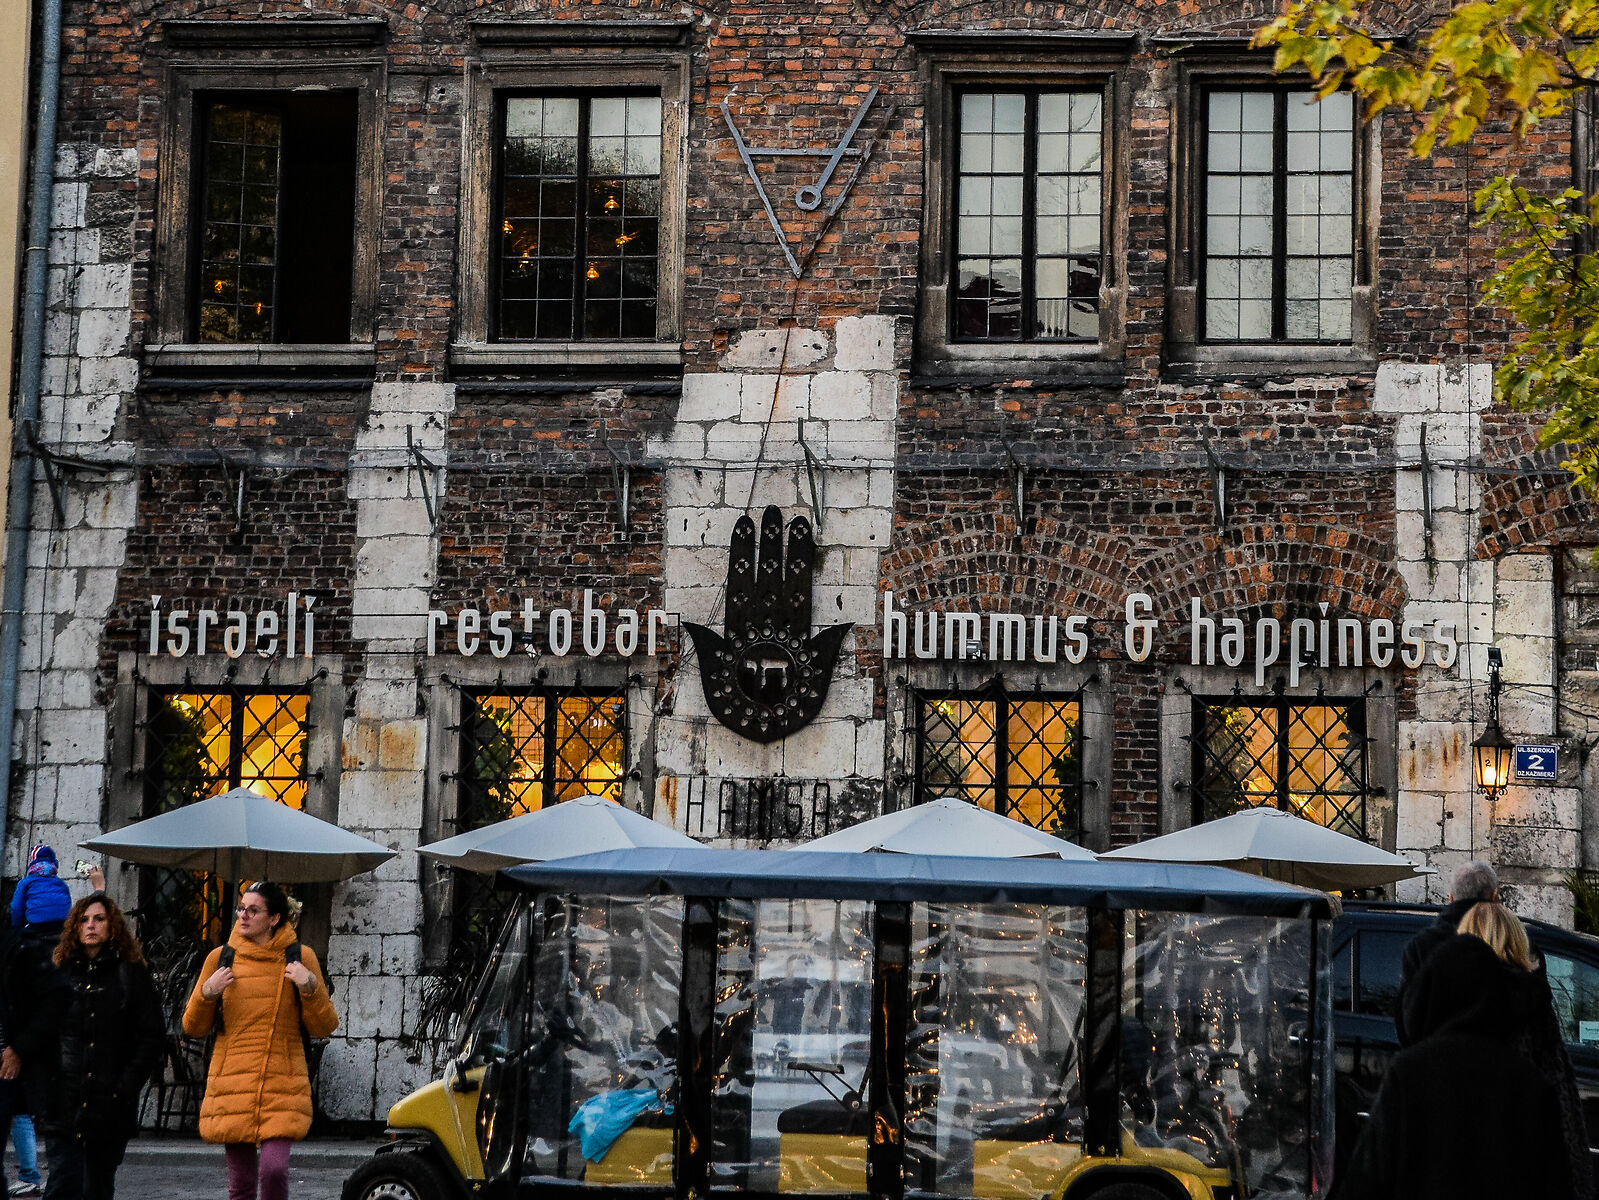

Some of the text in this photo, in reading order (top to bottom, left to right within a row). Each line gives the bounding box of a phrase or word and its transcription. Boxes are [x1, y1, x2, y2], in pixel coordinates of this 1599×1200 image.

[150, 588, 669, 659] israeli restobar
[883, 590, 1457, 688] hummus & happiness
[1527, 754, 1545, 770] 2
[685, 776, 831, 837] HAMSA
